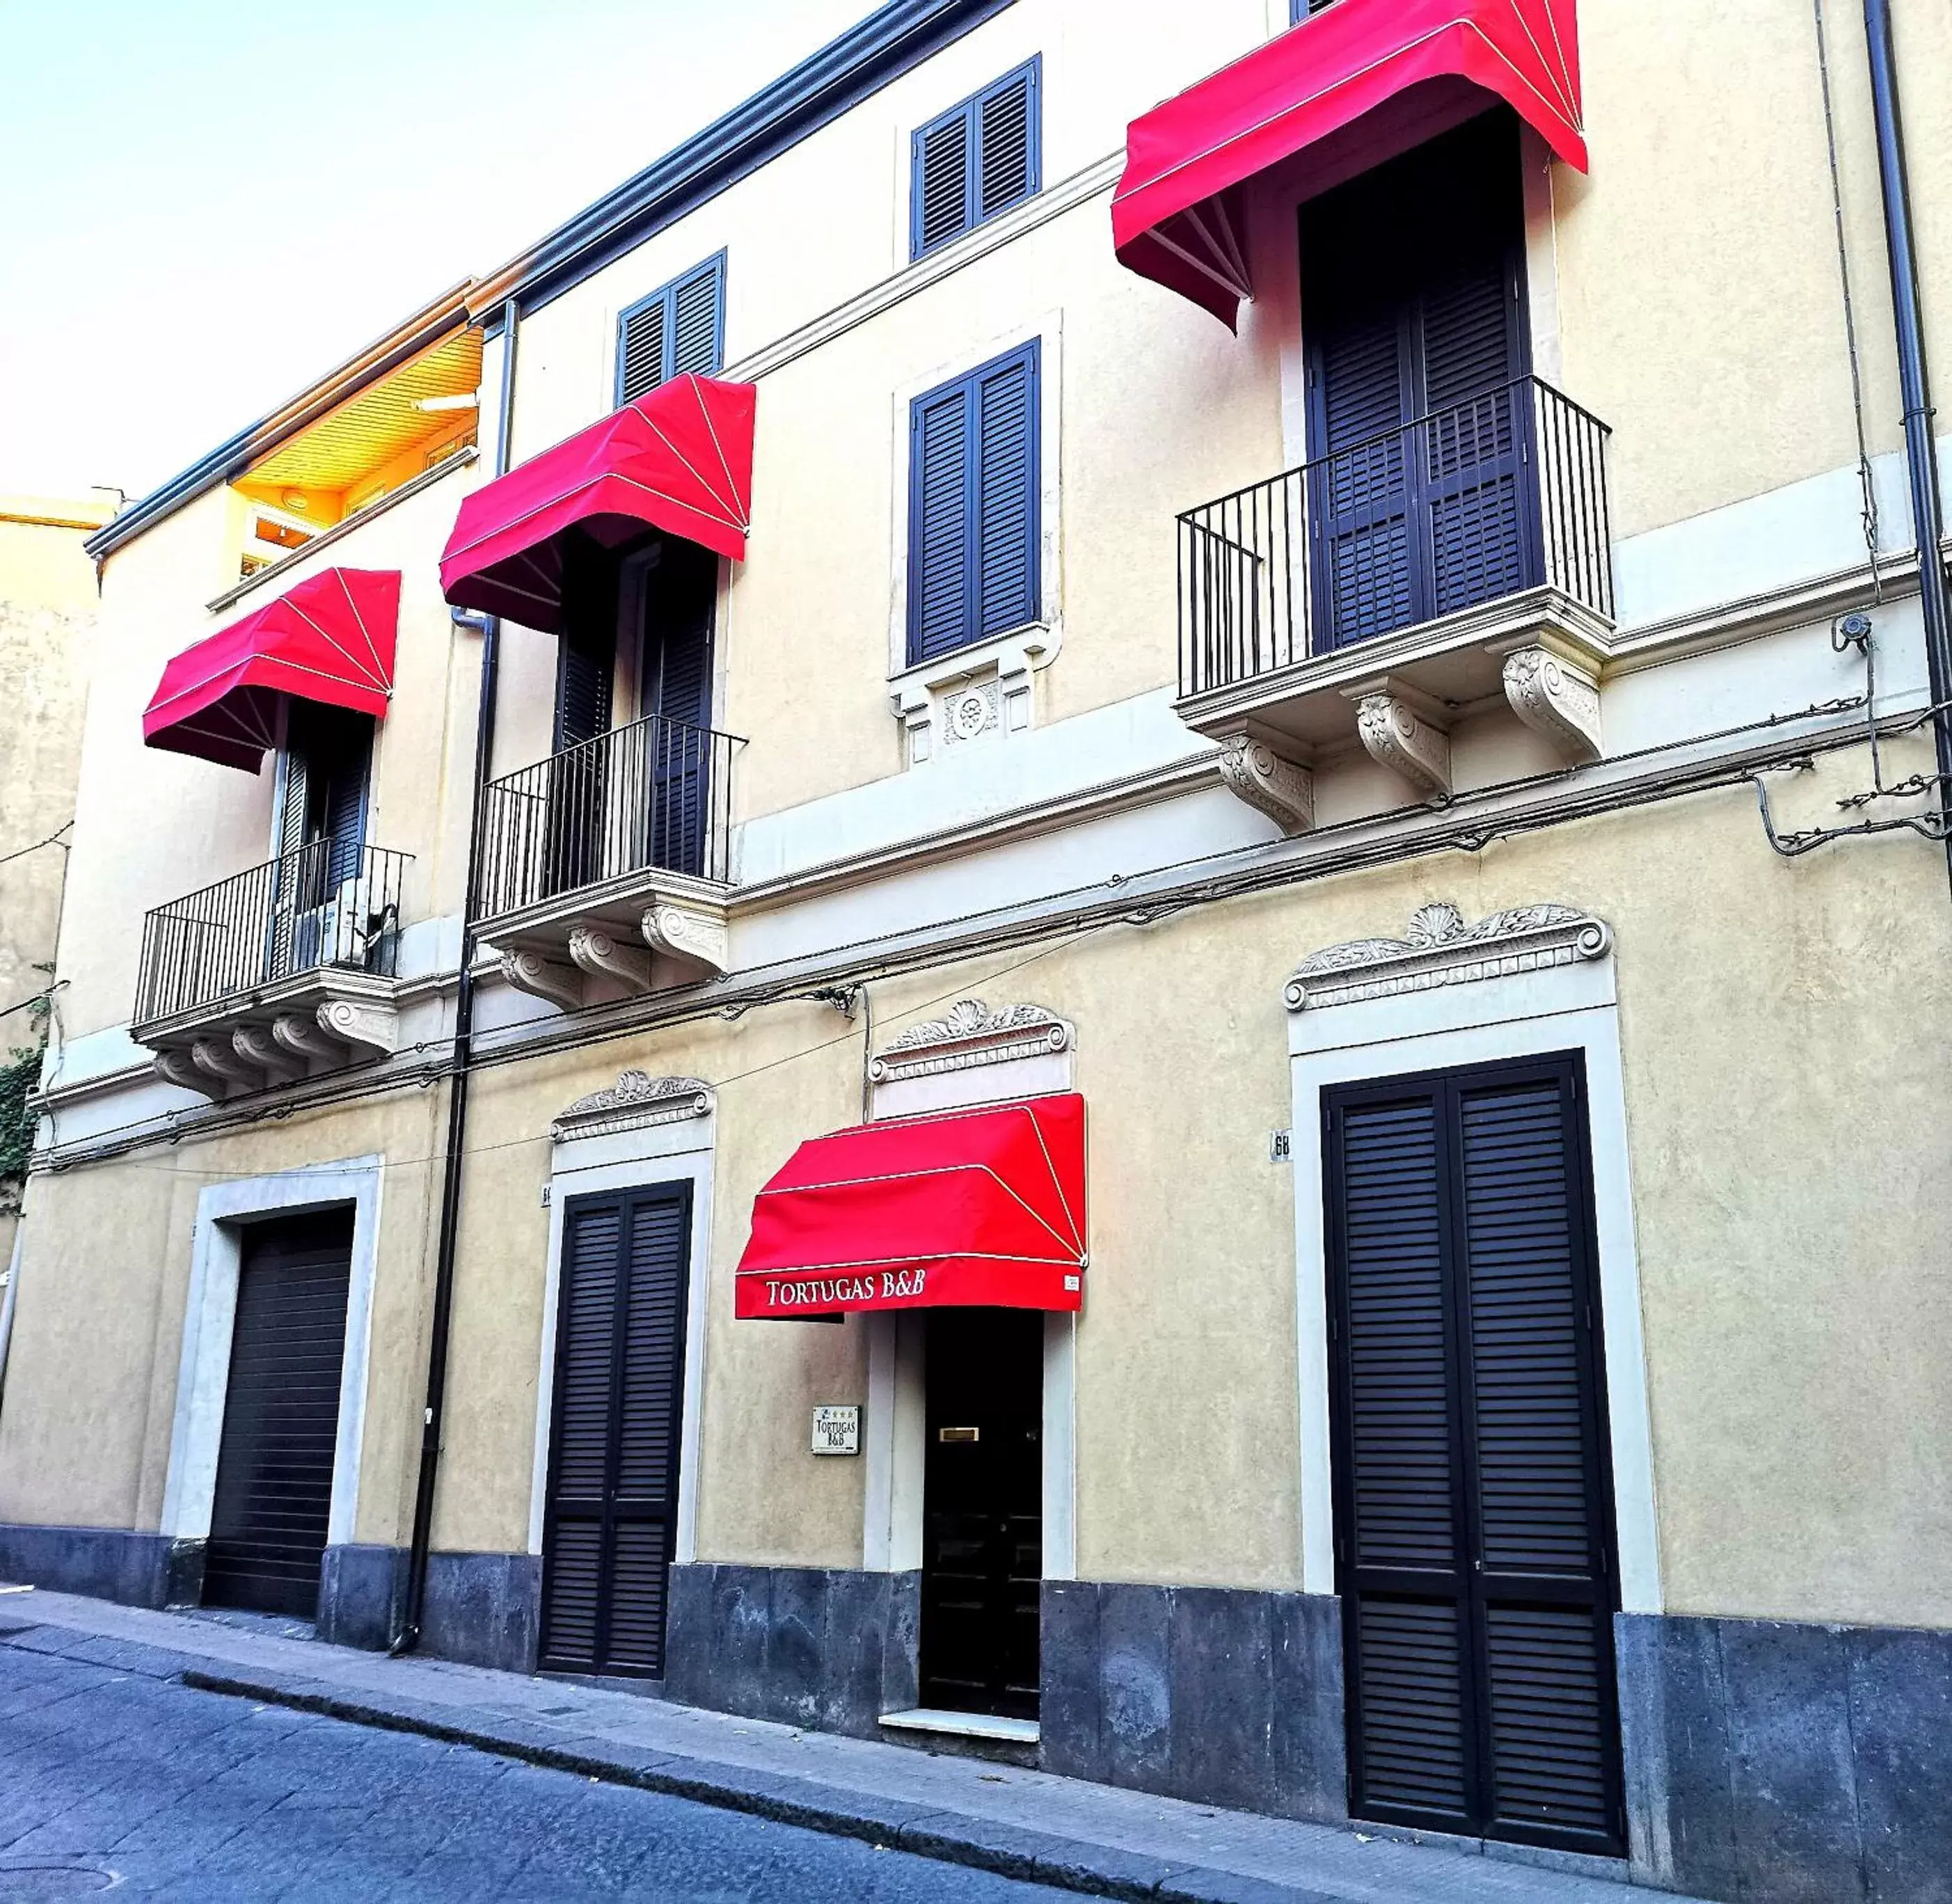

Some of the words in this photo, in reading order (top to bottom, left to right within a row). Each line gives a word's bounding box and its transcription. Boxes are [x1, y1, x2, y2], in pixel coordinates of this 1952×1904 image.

[1276, 1135, 1290, 1156] 68
[766, 1276, 874, 1306] TORTUGAS
[881, 1269, 926, 1298] B&B
[817, 1420, 855, 1434] TORTUGAS
